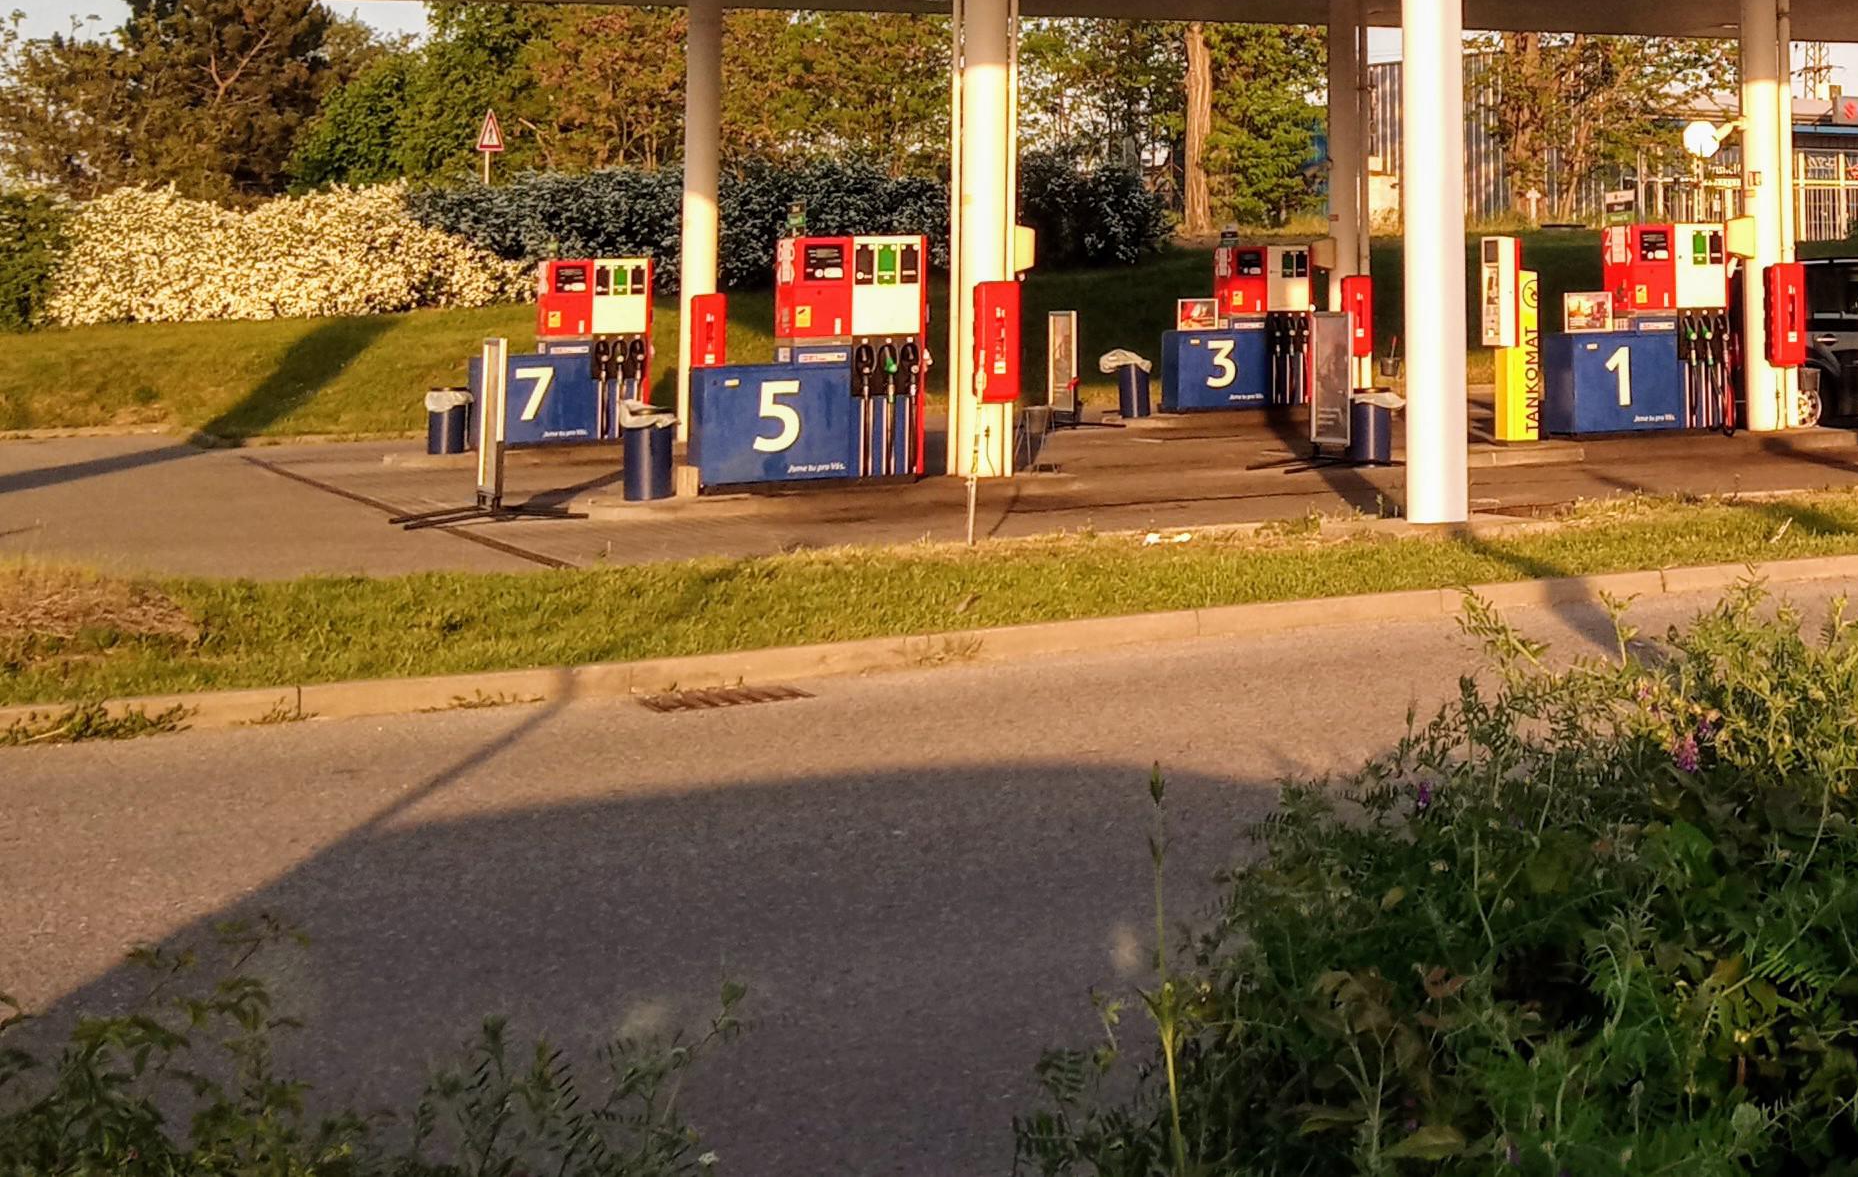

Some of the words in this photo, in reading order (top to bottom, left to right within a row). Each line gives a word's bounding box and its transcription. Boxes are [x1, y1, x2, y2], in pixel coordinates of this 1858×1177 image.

[515, 366, 554, 421] 7
[1206, 339, 1237, 388] 3
[1525, 326, 1539, 434] TANKOMAT
[1605, 346, 1631, 406] 1
[752, 379, 800, 452] 5
